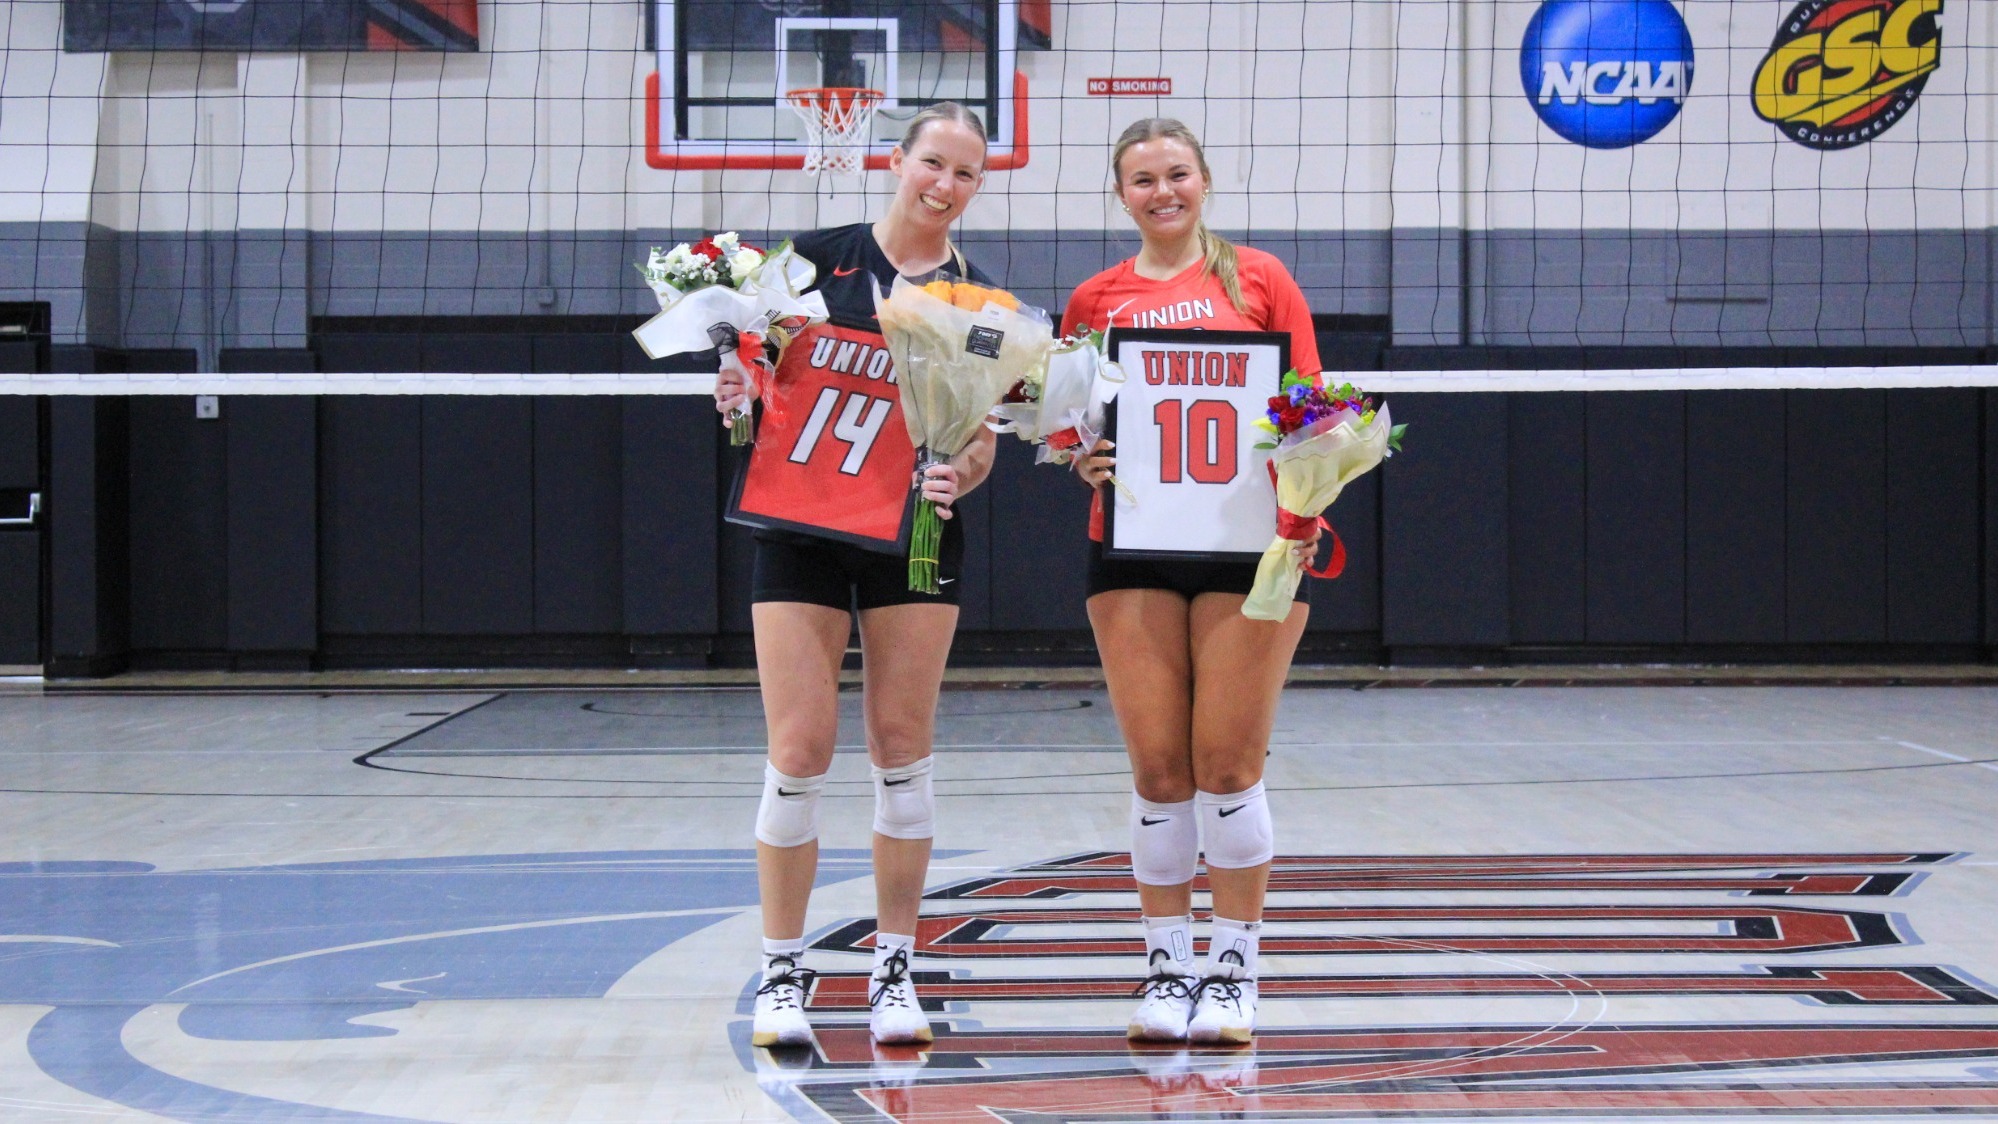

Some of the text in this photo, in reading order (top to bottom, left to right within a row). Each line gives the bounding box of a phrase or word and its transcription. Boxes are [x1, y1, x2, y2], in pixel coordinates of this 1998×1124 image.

[1089, 81, 1169, 92] NO SMOKING
[1538, 60, 1688, 105] NCAA
[1752, 0, 1943, 127] GSC
[1797, 88, 1915, 143] CONFERENCE
[1131, 298, 1214, 328] UNION
[1141, 350, 1250, 387] UNION
[787, 386, 894, 477] 14
[1153, 398, 1239, 485] 10
